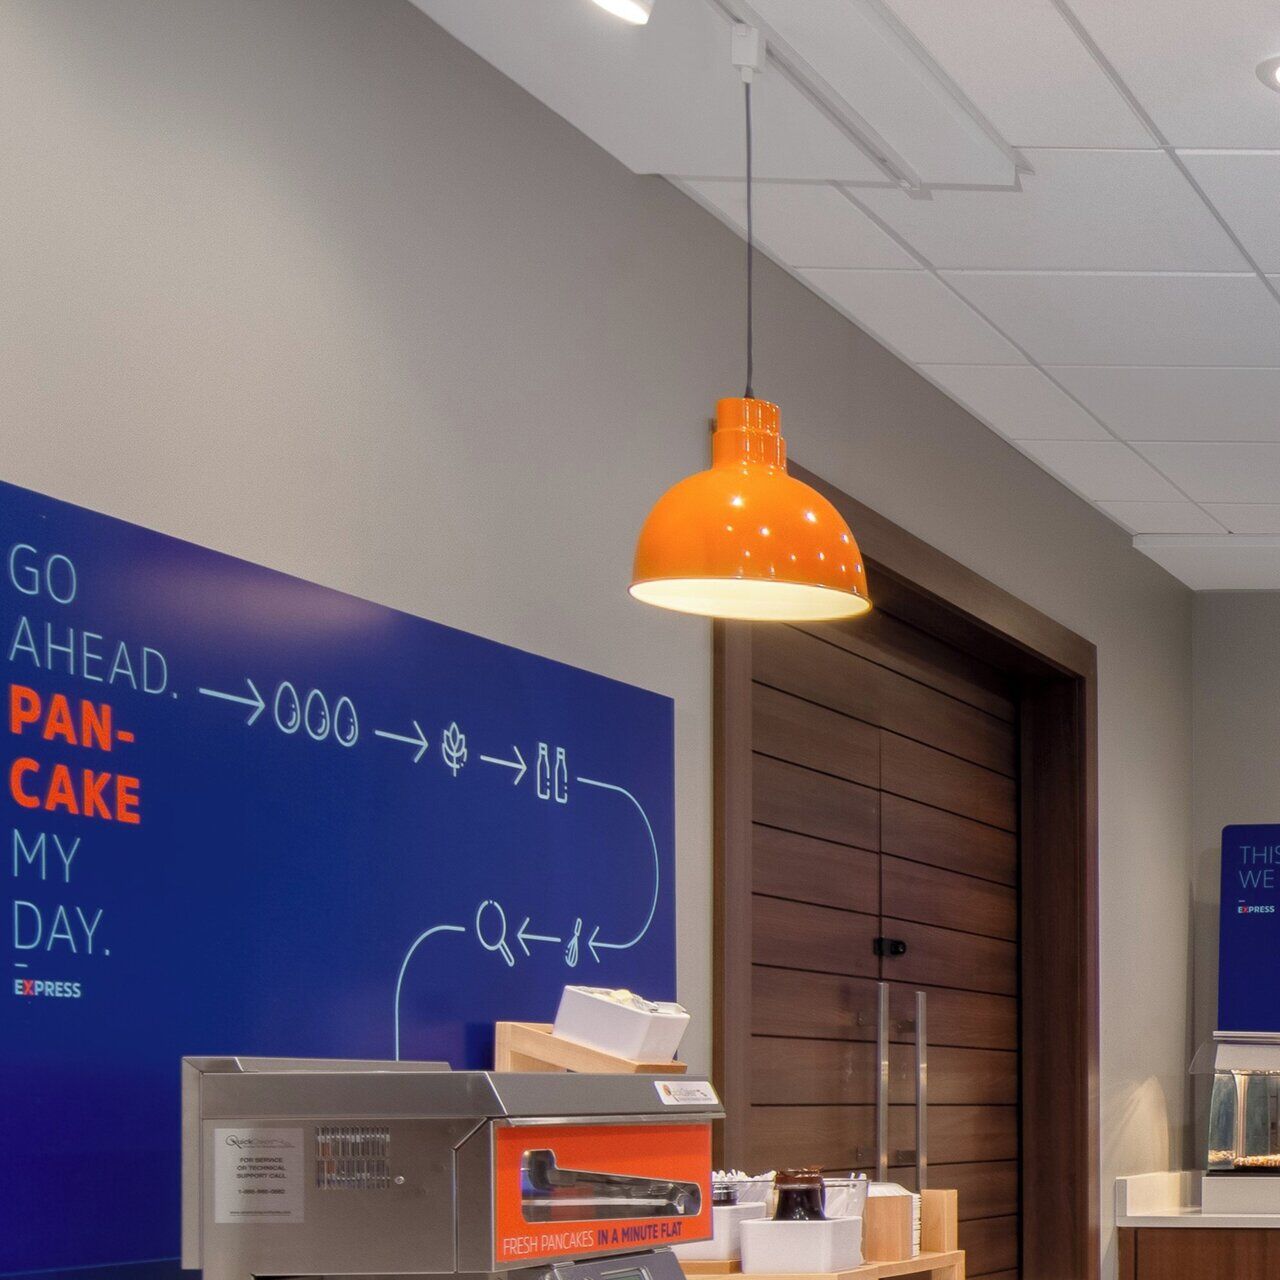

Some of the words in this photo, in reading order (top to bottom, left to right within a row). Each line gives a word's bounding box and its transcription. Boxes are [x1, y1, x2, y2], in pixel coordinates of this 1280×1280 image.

[8, 543, 77, 604] GO
[8, 616, 179, 699] AHEAD.
[8, 684, 135, 751] PAN-
[8, 757, 142, 824] CAKE
[12, 828, 81, 883] MY
[1239, 869, 1275, 888] WE
[13, 900, 111, 956] DAY.
[1237, 905, 1275, 914] EXPRESS
[14, 978, 82, 998] EXPRESS
[503, 1236, 537, 1256] FRESH
[541, 1230, 595, 1251] PANCAKES
[597, 1229, 609, 1246] IN
[611, 1228, 619, 1242] A
[621, 1224, 659, 1241] MINUTE
[660, 1221, 683, 1237] FLAT
